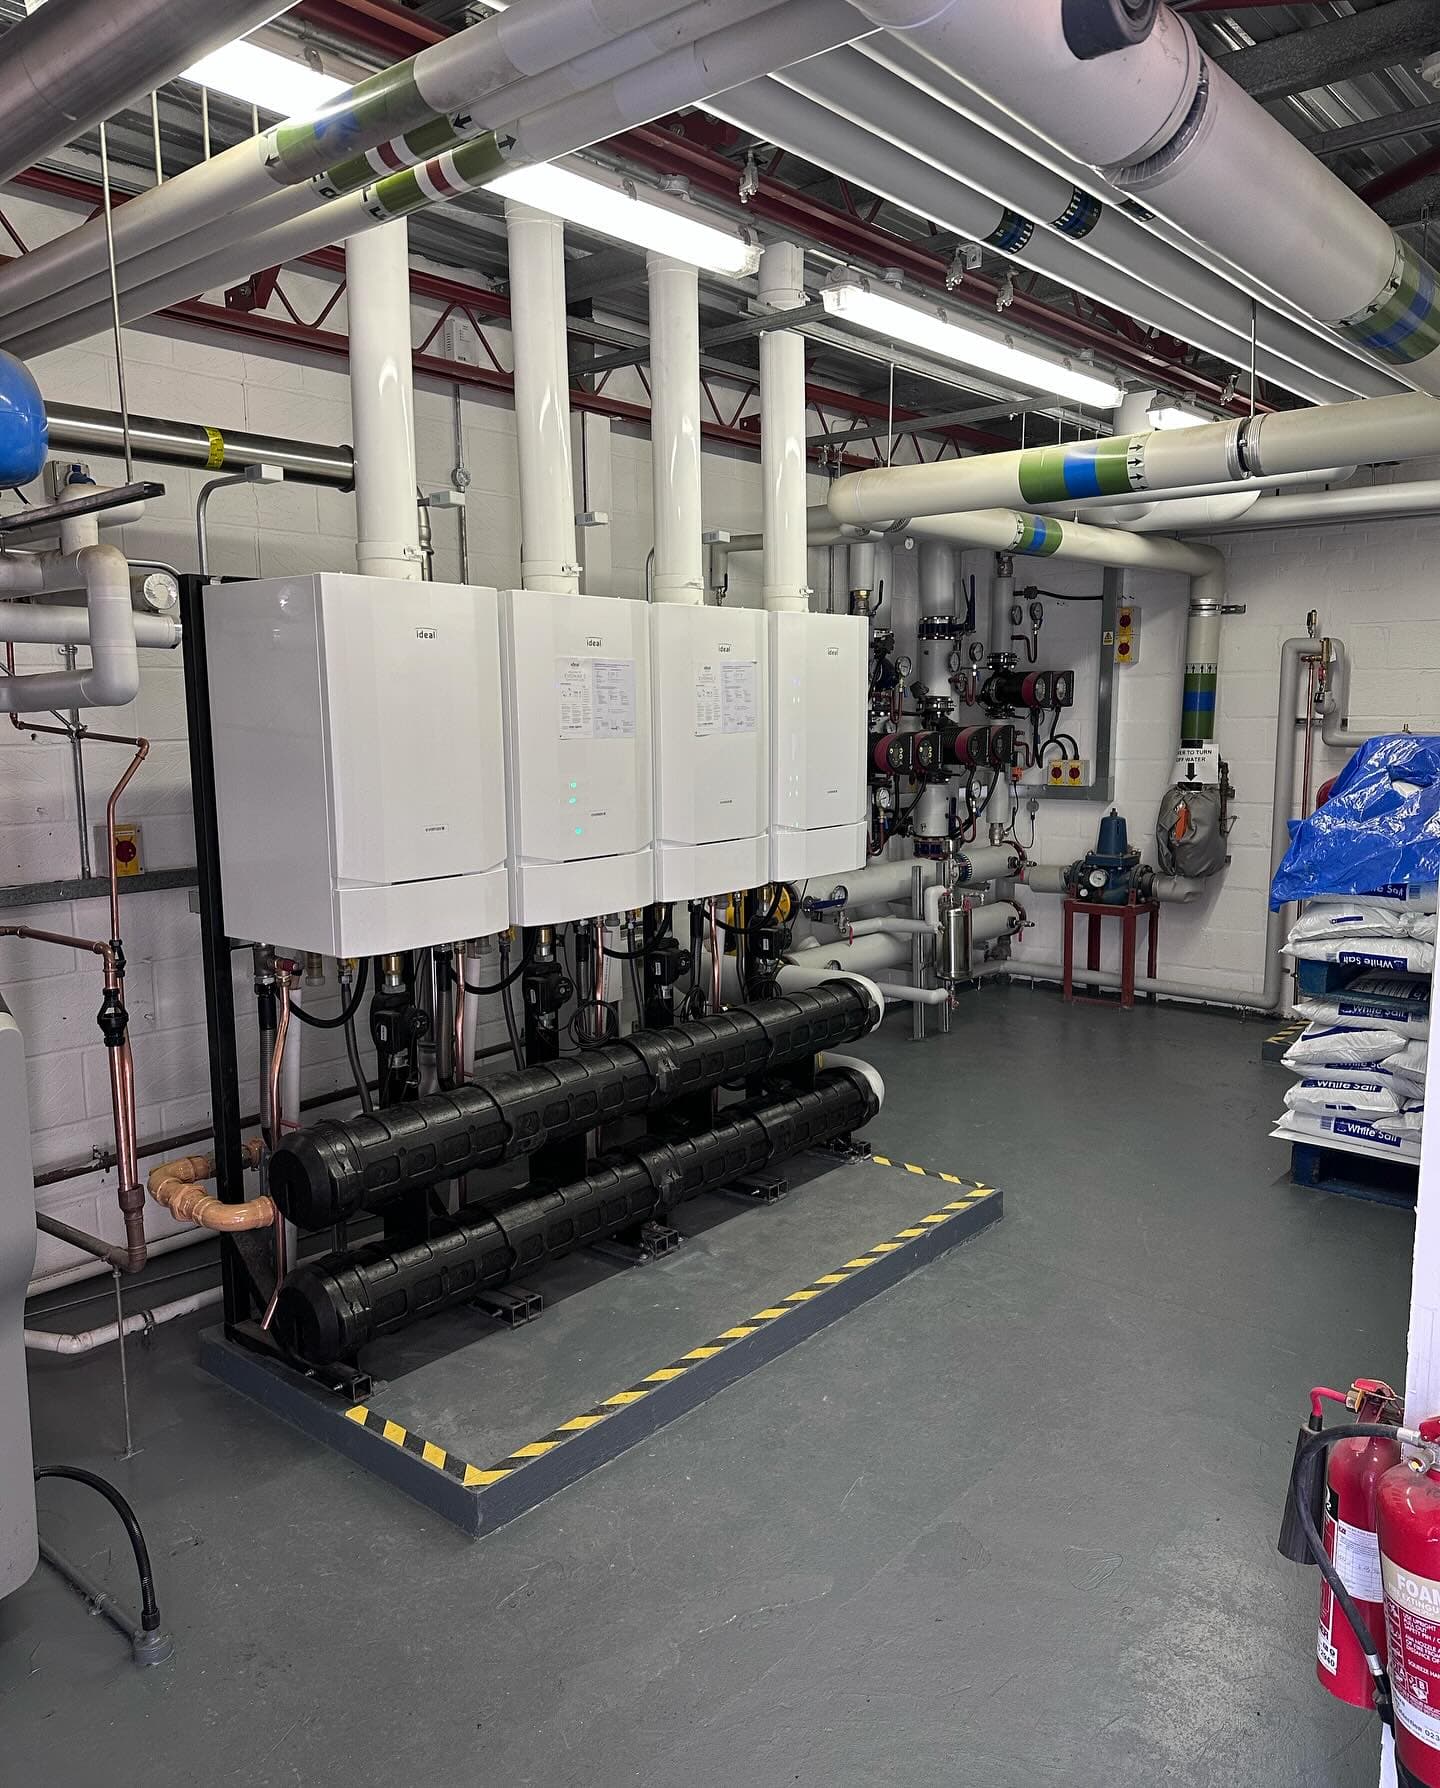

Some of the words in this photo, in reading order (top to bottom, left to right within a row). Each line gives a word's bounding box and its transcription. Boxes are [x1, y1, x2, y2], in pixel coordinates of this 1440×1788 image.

[416, 629, 436, 639] ideal
[586, 639, 602, 647] ideal
[1386, 885, 1404, 897] Salt
[1343, 955, 1361, 965] Salt
[1364, 958, 1393, 969] White
[1353, 1004, 1382, 1015] White
[1384, 1008, 1404, 1018] Salt
[1317, 1080, 1350, 1089] White
[1353, 1082, 1378, 1092] Salt
[1347, 1123, 1376, 1138] White
[1378, 1130, 1397, 1143] Salt
[1413, 1617, 1436, 1632] UPRIGHT
[1414, 1639, 1436, 1653] NOZZLE
